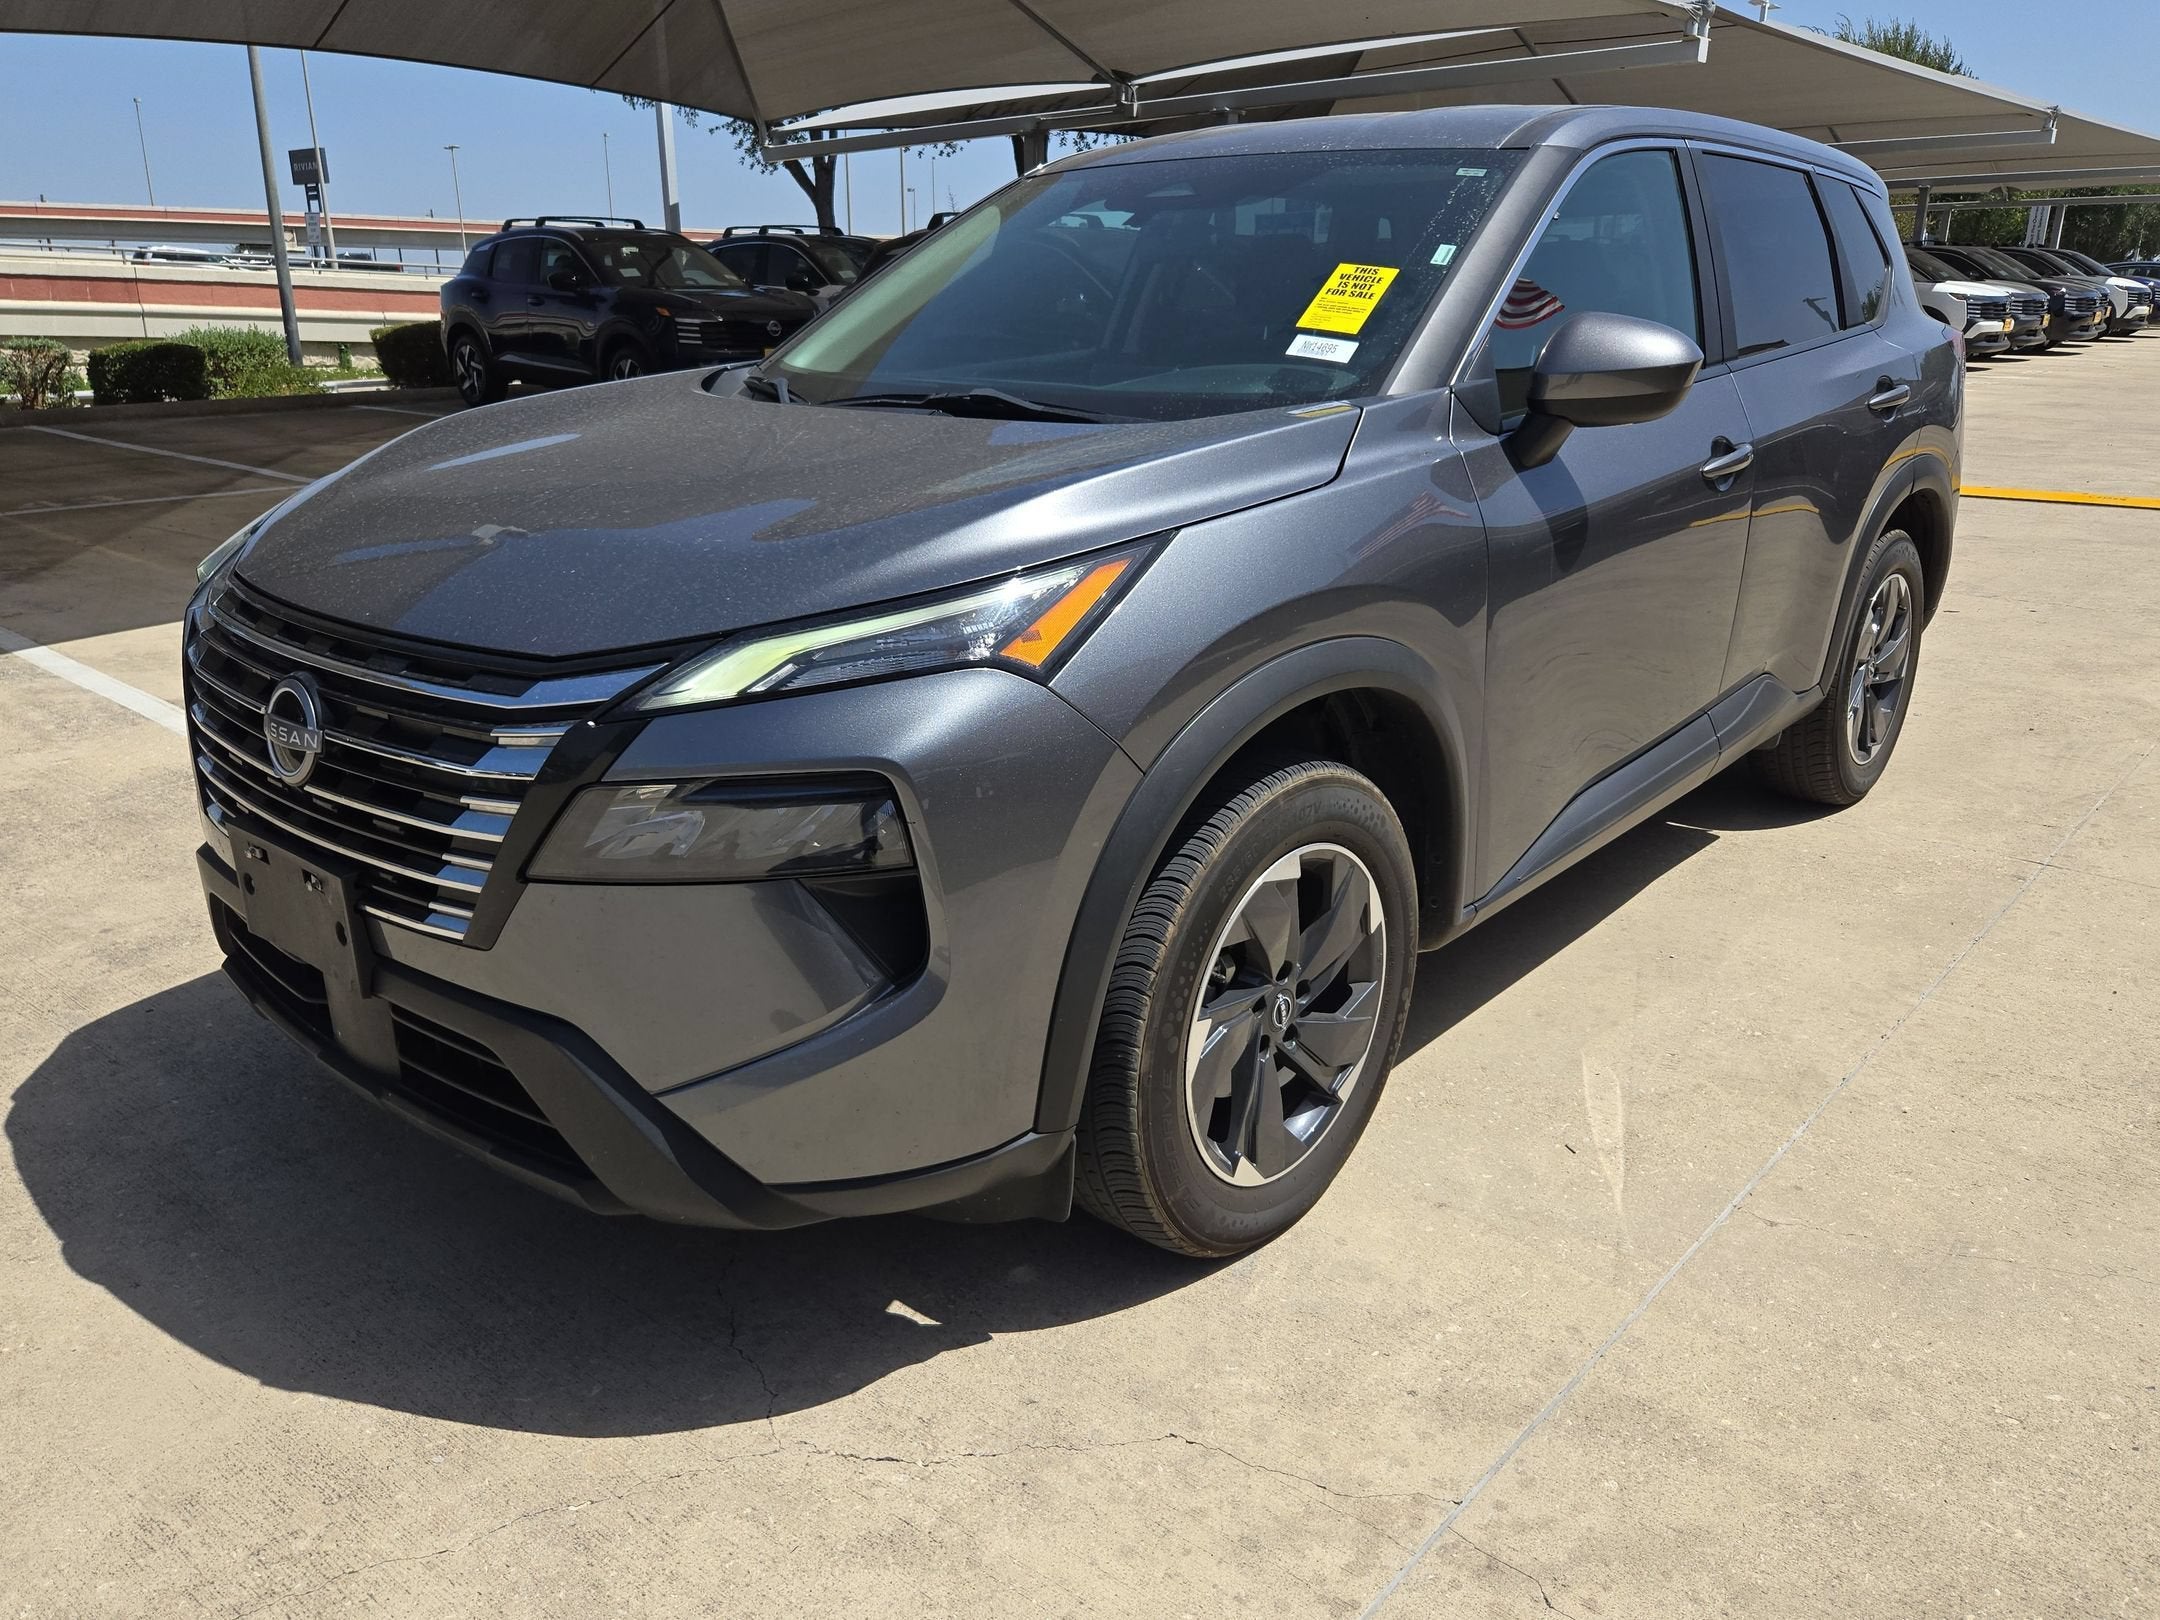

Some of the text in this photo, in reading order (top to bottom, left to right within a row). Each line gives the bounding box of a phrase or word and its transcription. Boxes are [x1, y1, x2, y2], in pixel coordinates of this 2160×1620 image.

[293, 163, 318, 171] RIVIAN
[1354, 267, 1380, 275] THIS
[1339, 273, 1384, 284] VEHICLE
[1337, 281, 1375, 291] IS NOT
[1326, 288, 1376, 300] FOR SALE
[270, 722, 318, 749] SSAN
